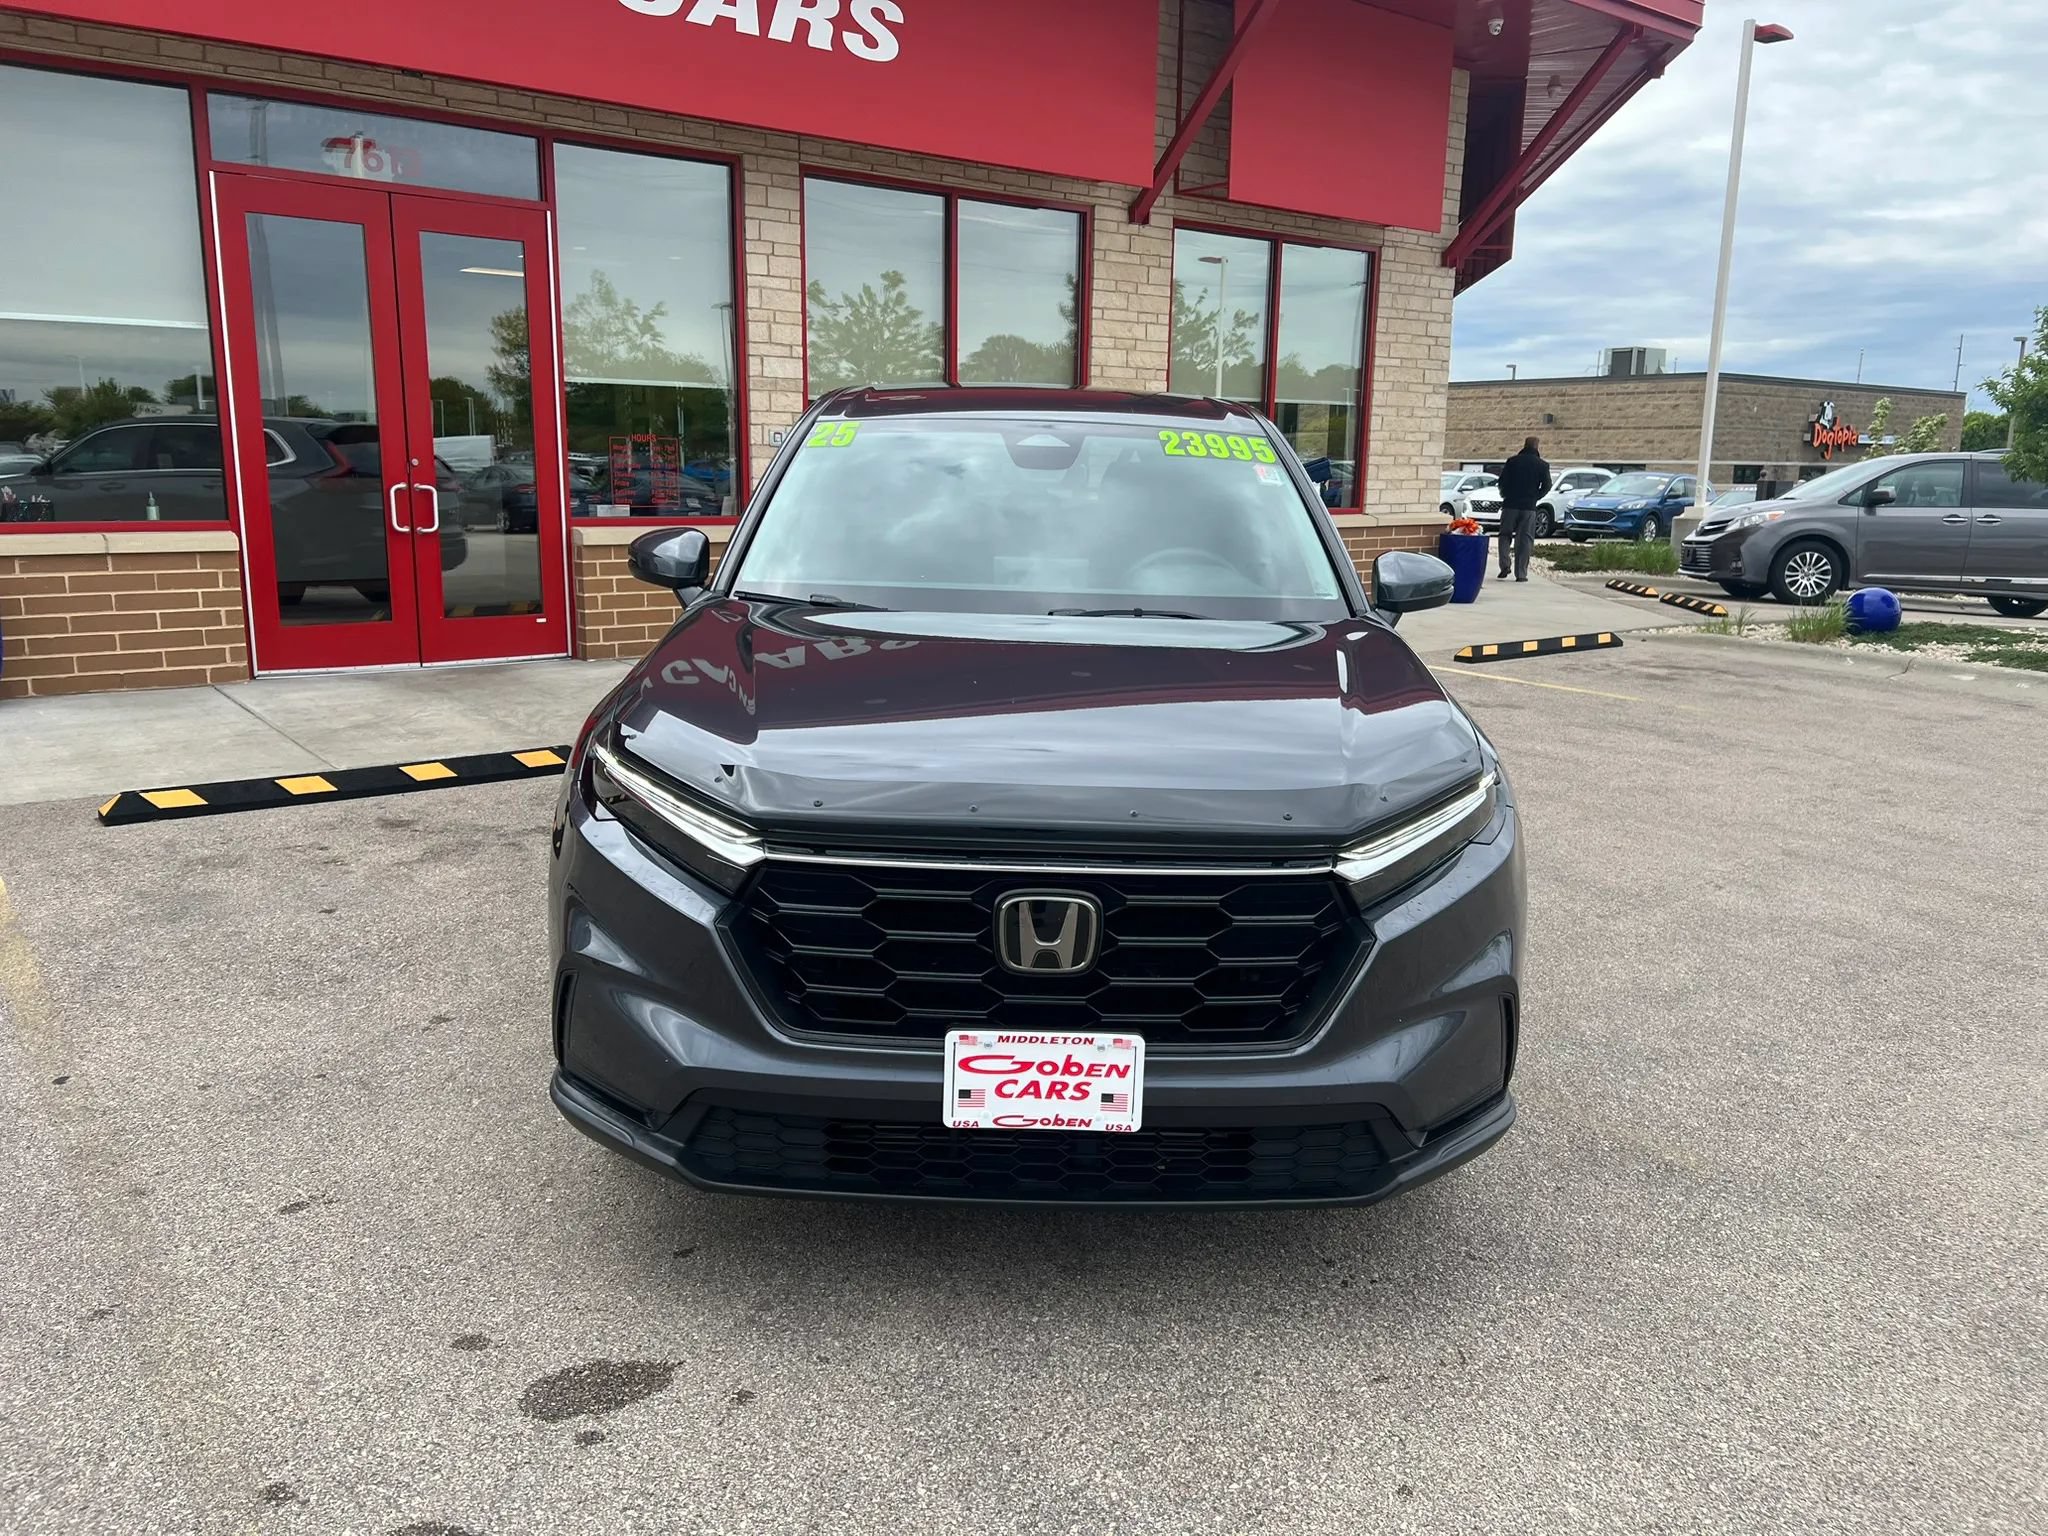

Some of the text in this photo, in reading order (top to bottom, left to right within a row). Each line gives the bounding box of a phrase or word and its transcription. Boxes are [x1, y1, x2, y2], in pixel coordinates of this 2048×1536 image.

[618, 0, 904, 62] ARS
[631, 433, 657, 442] HOURS
[807, 421, 860, 447] 25
[1813, 416, 1858, 460] Dogtopia
[1158, 430, 1277, 464] 23995
[997, 1034, 1095, 1046] MIDDLETON
[994, 1079, 1093, 1101] CARS
[952, 1120, 980, 1128] USA
[1105, 1123, 1133, 1132] USA
